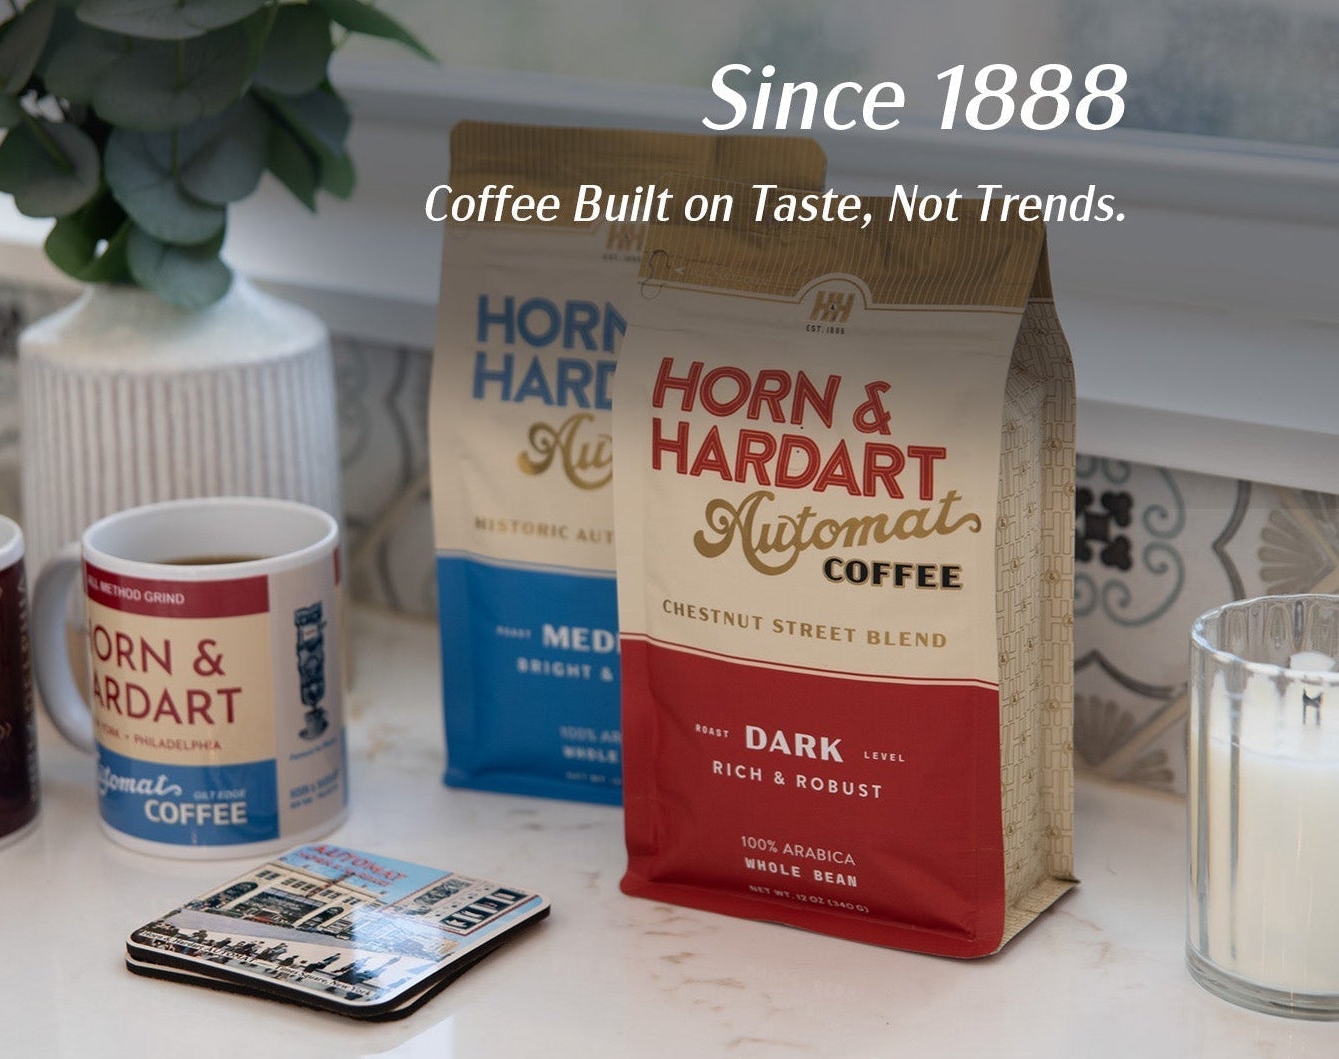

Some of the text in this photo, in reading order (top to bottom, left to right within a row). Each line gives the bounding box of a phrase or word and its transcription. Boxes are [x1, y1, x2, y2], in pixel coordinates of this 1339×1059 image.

[652, 357, 892, 435] HORN &
[652, 417, 947, 500] HARDART
[475, 516, 568, 540] HISTORIC
[693, 490, 982, 576] Automat
[822, 556, 963, 590] COFFEE
[100, 580, 141, 600] METHOD
[144, 590, 185, 605] GRIND
[662, 599, 948, 648] CHESTNUT STREET BLEND
[90, 624, 226, 676] ORN &
[517, 657, 592, 680] BRIGHT
[93, 671, 242, 725] ARDART
[134, 734, 222, 750] PHILADELPHIA
[695, 723, 905, 763] ROAST DARK LEVEL
[713, 760, 882, 798] RICH & ROBUST
[144, 799, 248, 826] COFFEE
[741, 835, 856, 866] 100% ARABICA
[744, 857, 857, 887] WHOLE BEAN
[749, 885, 771, 895] NET
[809, 896, 825, 905] OZ
